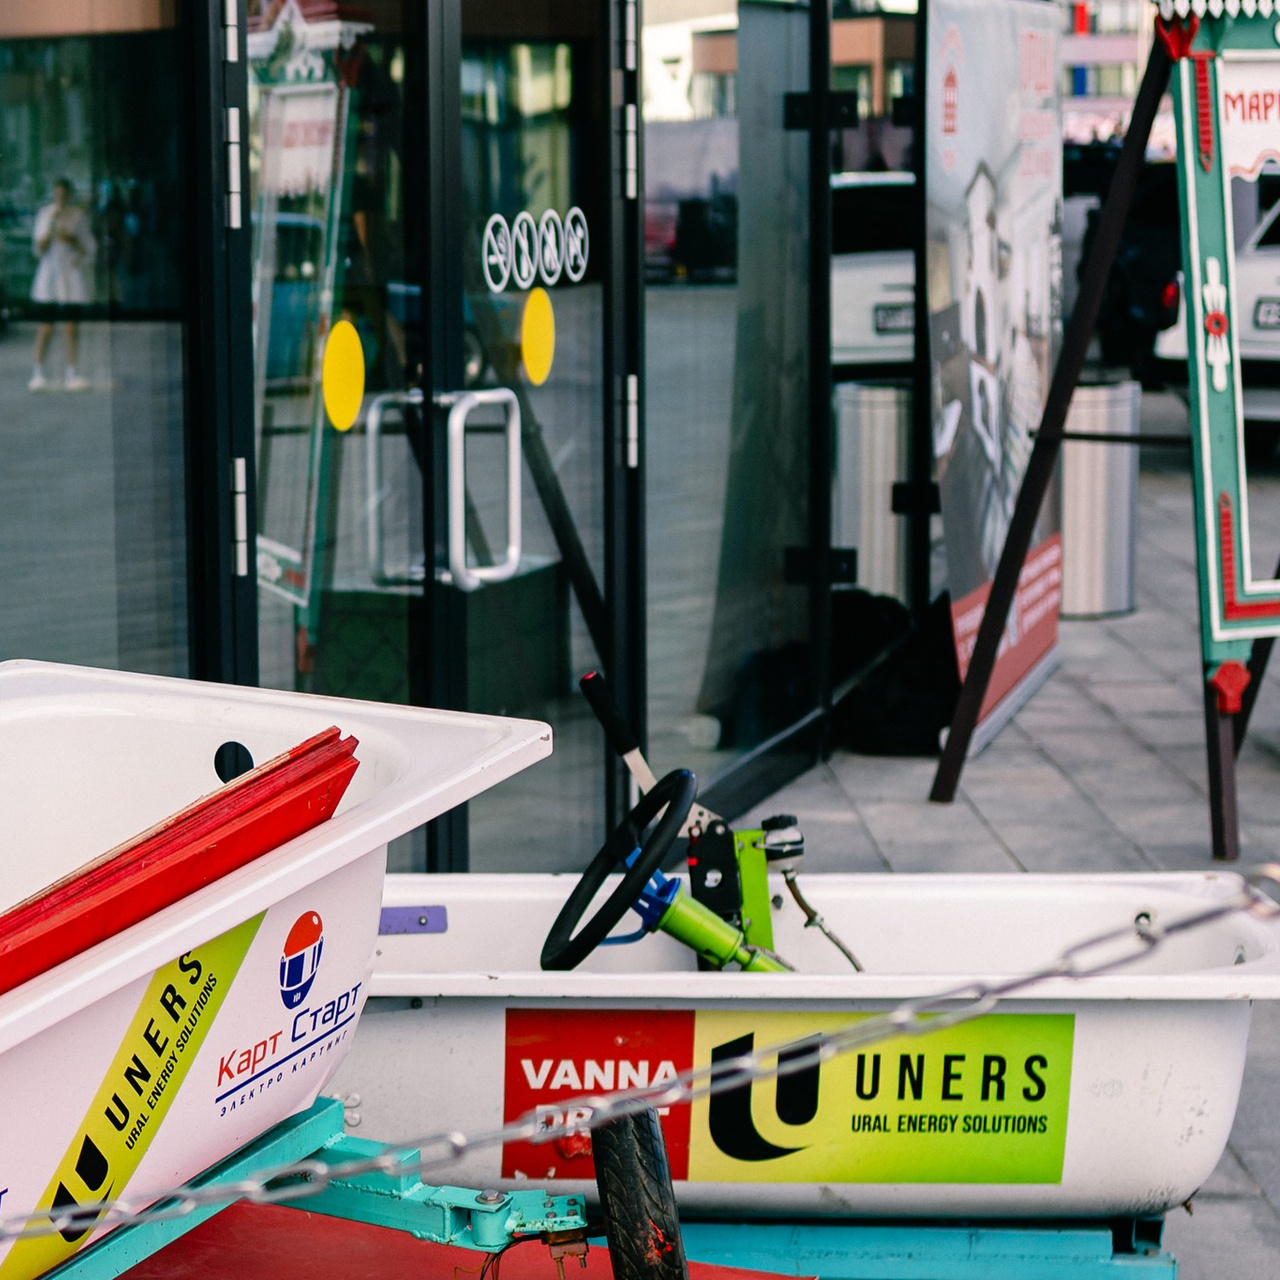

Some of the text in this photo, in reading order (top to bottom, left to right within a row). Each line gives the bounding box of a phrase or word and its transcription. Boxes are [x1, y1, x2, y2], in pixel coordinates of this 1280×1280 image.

[1224, 92, 1280, 121] МАР
[104, 951, 203, 1132] UNERS
[125, 972, 218, 1150] URAL ENERGY SOLUTIONS
[217, 981, 363, 1088] Карт Старт
[220, 1030, 348, 1117] ЭЛЕКТРО КАРТИНГ
[521, 1059, 681, 1091] VANNA
[855, 1053, 1048, 1102] UNERS
[851, 1114, 1048, 1134] URAL ENERGY SOLUTIONS
